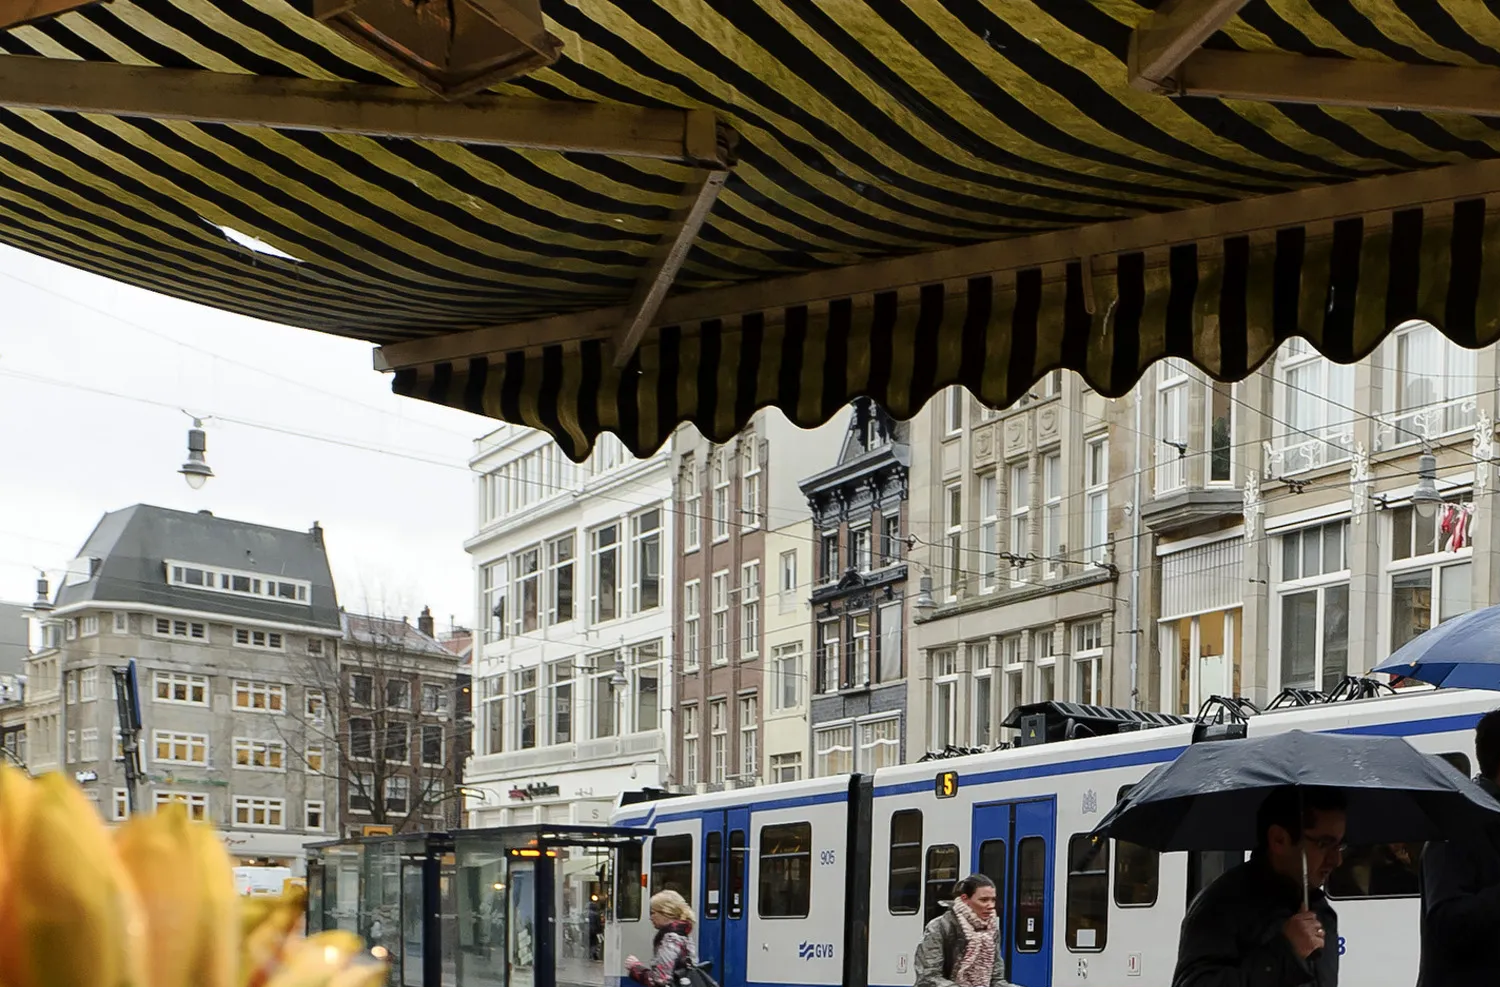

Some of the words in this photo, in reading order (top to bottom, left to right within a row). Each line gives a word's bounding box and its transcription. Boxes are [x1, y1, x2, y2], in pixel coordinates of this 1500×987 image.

[944, 773, 953, 795] 5
[820, 850, 836, 866] 905
[815, 943, 834, 958] GVB
